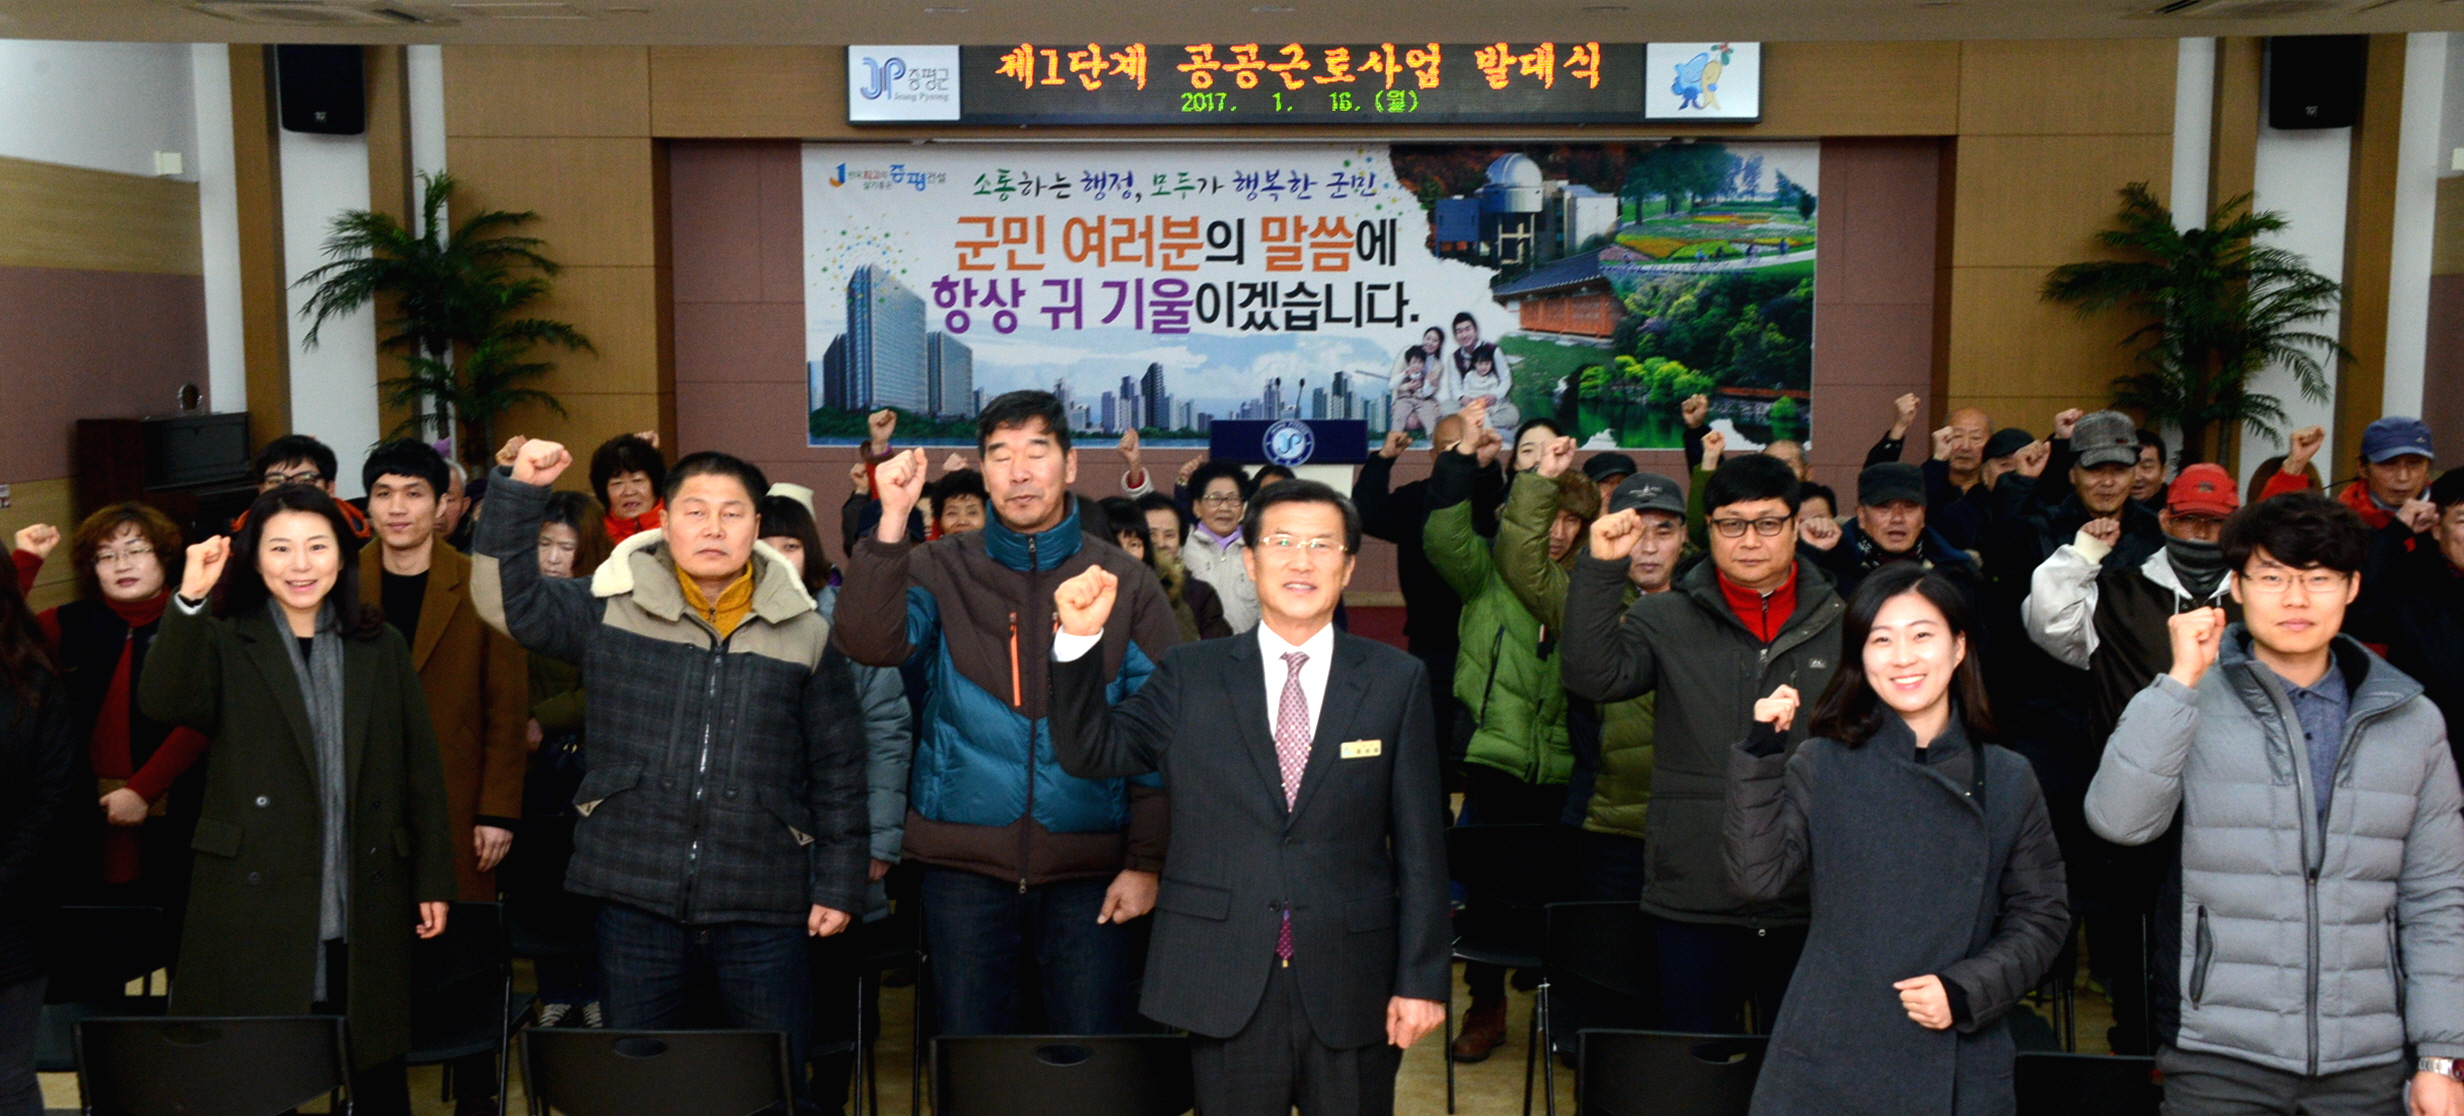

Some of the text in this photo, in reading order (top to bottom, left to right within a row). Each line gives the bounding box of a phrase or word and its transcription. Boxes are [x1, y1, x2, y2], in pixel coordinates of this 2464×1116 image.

[908, 68, 949, 91] 증평군
[996, 42, 1600, 91] 제1단계 공공근로사업 발대식
[1181, 91, 1419, 112] 2017. 1. 16. (월)
[973, 169, 1376, 203] 소통하는 행정, 모두가 행복한 군민
[955, 214, 1397, 272] 군민 여러분의 말씀에
[930, 275, 1420, 335] 항상 귀 기울이겠습니다.
